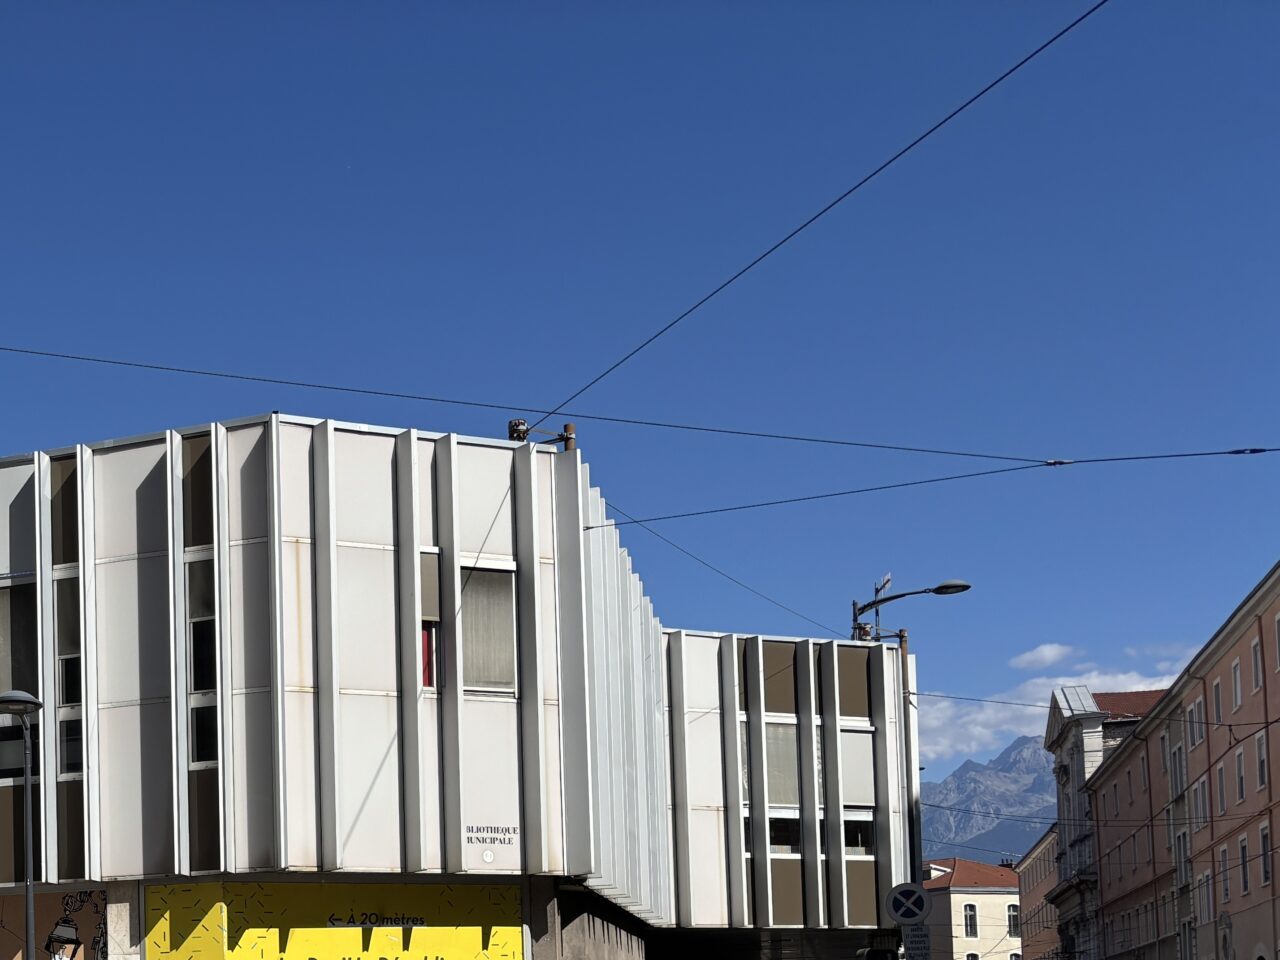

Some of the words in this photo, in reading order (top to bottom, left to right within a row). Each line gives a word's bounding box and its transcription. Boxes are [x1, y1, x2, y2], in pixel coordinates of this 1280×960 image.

[346, 908, 356, 925] À
[360, 913, 379, 925] 20
[382, 912, 425, 925] mètres
